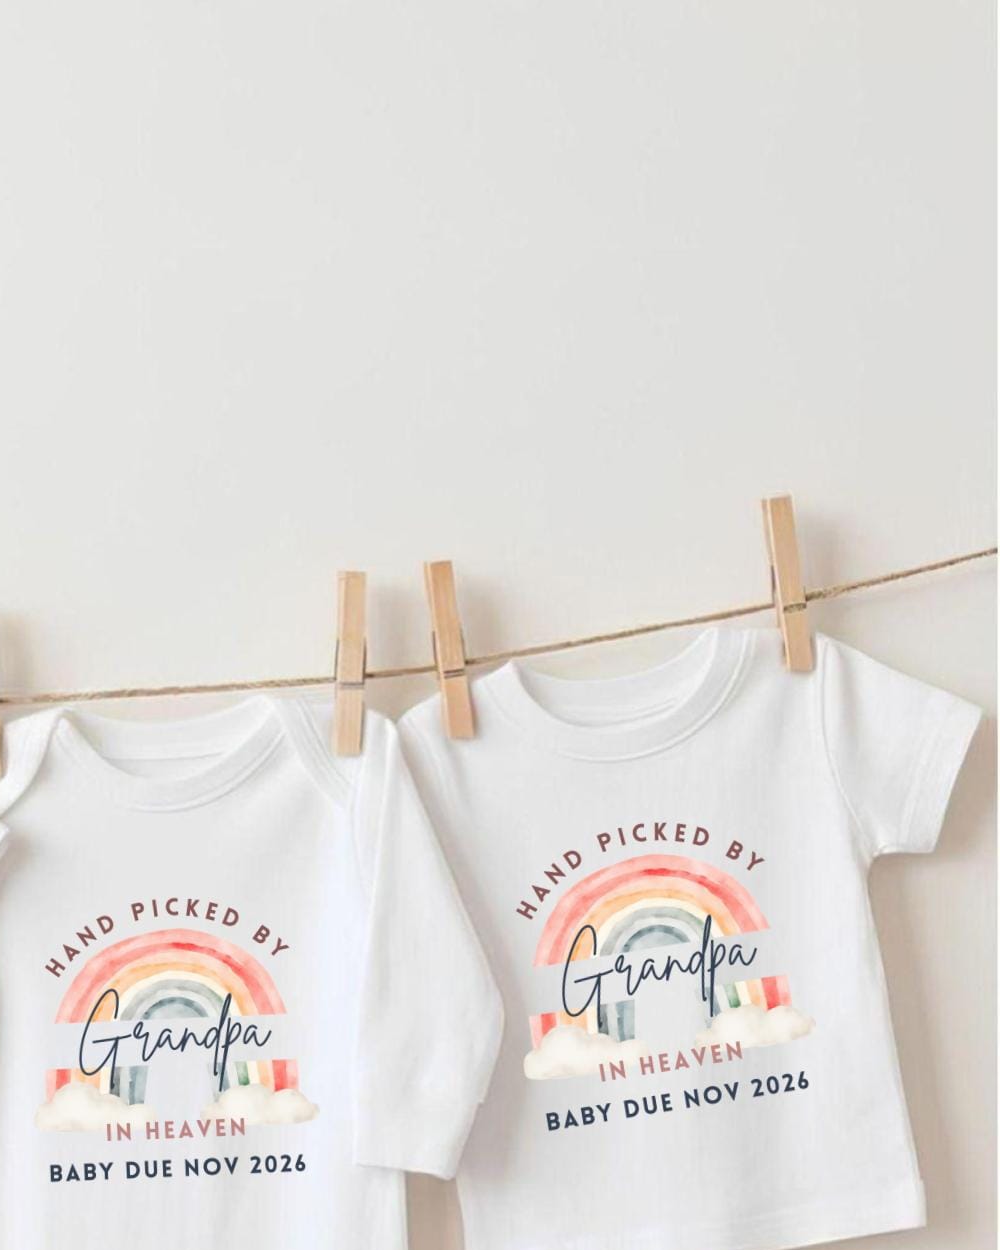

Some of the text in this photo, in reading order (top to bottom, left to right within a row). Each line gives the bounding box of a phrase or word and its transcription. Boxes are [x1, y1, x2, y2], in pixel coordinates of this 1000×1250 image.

[516, 822, 765, 920] HAND PICKED BY
[45, 898, 289, 977] HAND PICKED BY
[562, 914, 757, 1026] Grandpa
[79, 989, 272, 1092] Grandpa
[599, 1041, 743, 1082] IN HEAVEN
[106, 1118, 246, 1141] IN HEAVEN
[546, 1071, 809, 1131] BABY DUE NOV 2026
[50, 1154, 306, 1182] BABY DUE NOV 2026
